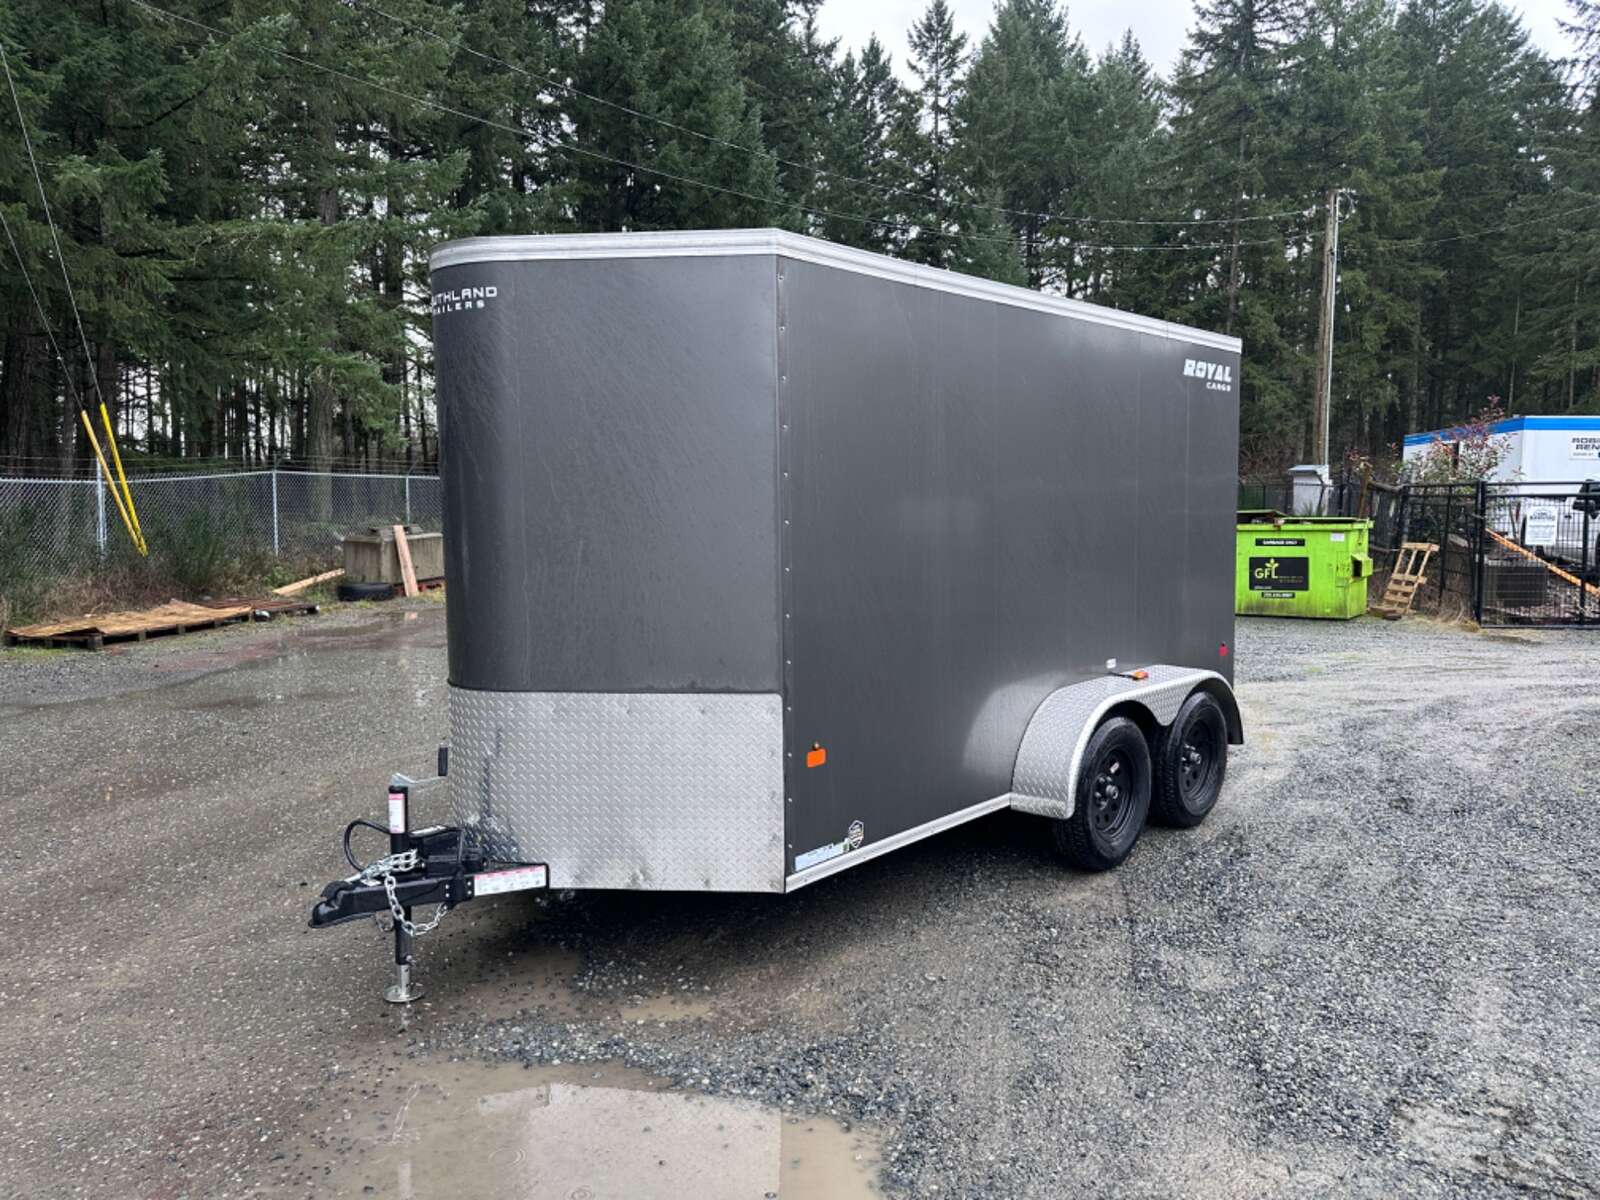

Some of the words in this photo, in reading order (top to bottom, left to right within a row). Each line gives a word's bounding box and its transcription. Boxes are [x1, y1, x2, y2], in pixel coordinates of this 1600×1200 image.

[1183, 358, 1232, 383] ROYAL
[1206, 381, 1231, 392] CARGO
[1254, 566, 1279, 579] GFL
